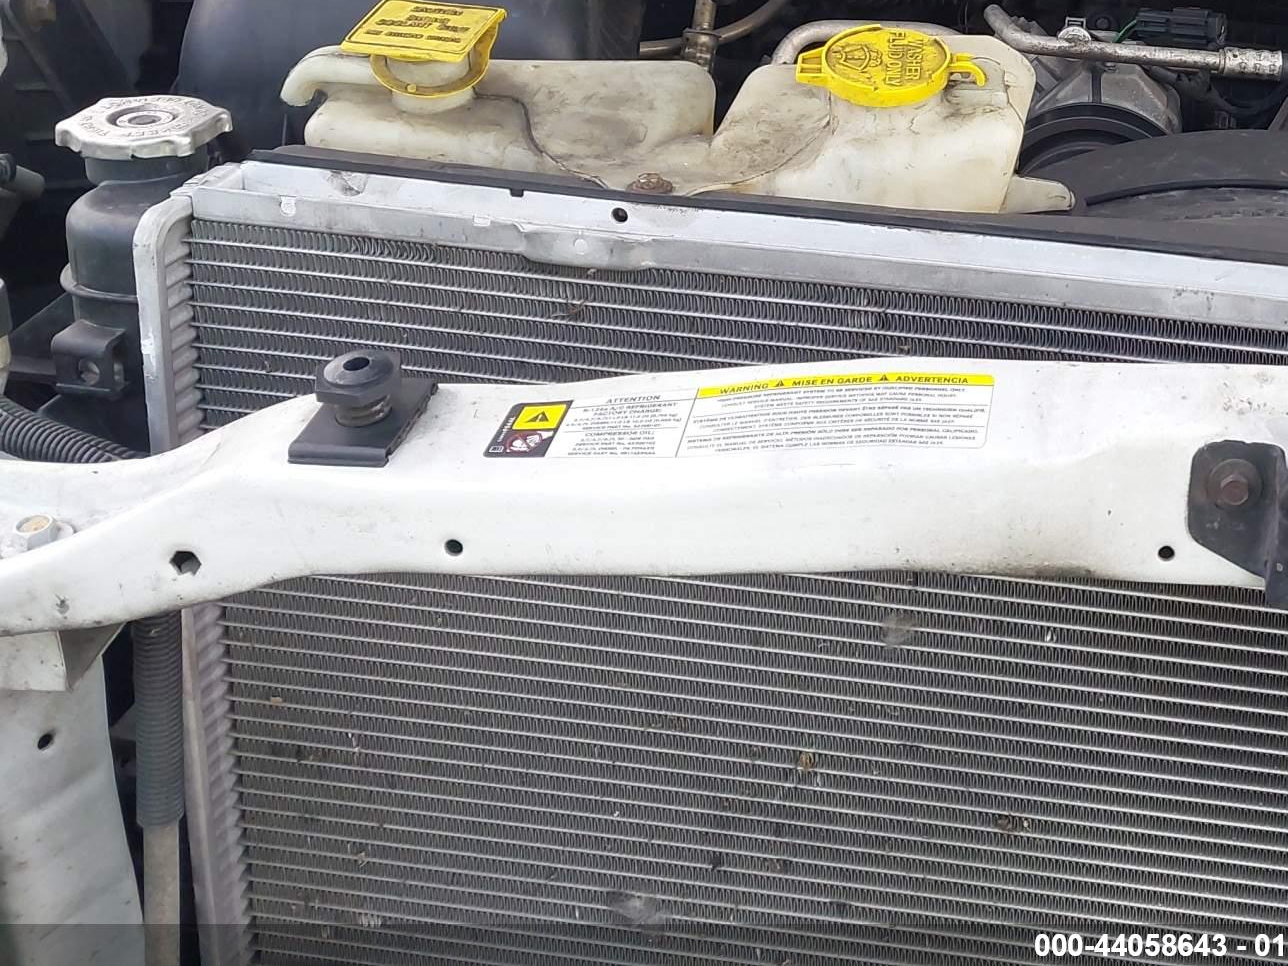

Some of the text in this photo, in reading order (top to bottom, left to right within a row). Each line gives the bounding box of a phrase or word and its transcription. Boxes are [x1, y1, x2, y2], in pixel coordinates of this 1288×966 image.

[885, 30, 905, 86] FLUID ONLY
[905, 38, 924, 81] WASHER
[605, 394, 661, 404] ATTENTION
[719, 374, 969, 394] WARNING MISE EN GARDE ADVERTENCIA
